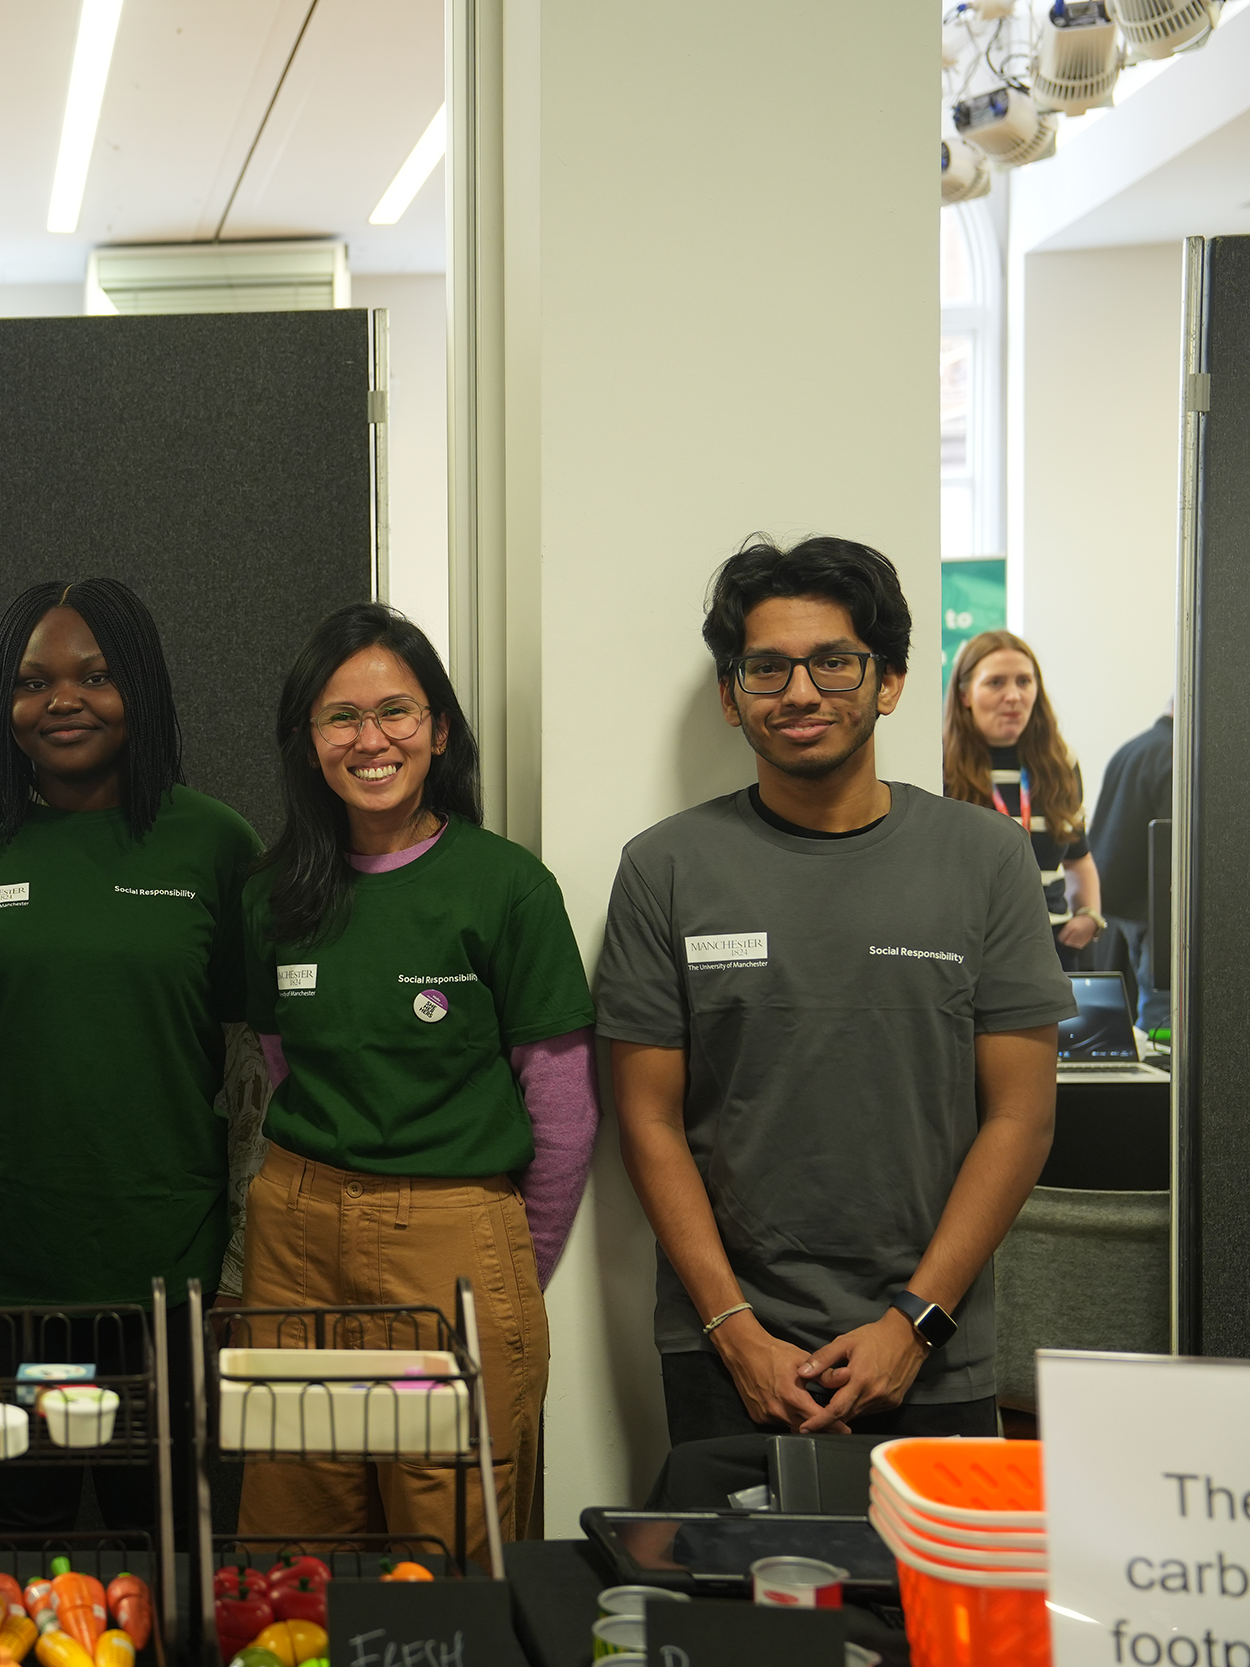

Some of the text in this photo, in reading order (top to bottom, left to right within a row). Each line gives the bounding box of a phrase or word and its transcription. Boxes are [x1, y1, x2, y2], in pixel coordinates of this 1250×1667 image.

[114, 885, 196, 900] Social Responsibility
[690, 937, 764, 952] MANCHESTER
[731, 948, 748, 957] 1824
[869, 945, 965, 964] Social Responsibility
[699, 963, 726, 971] University
[726, 961, 732, 969] of
[732, 960, 769, 968] Manchester
[397, 973, 425, 984] Social
